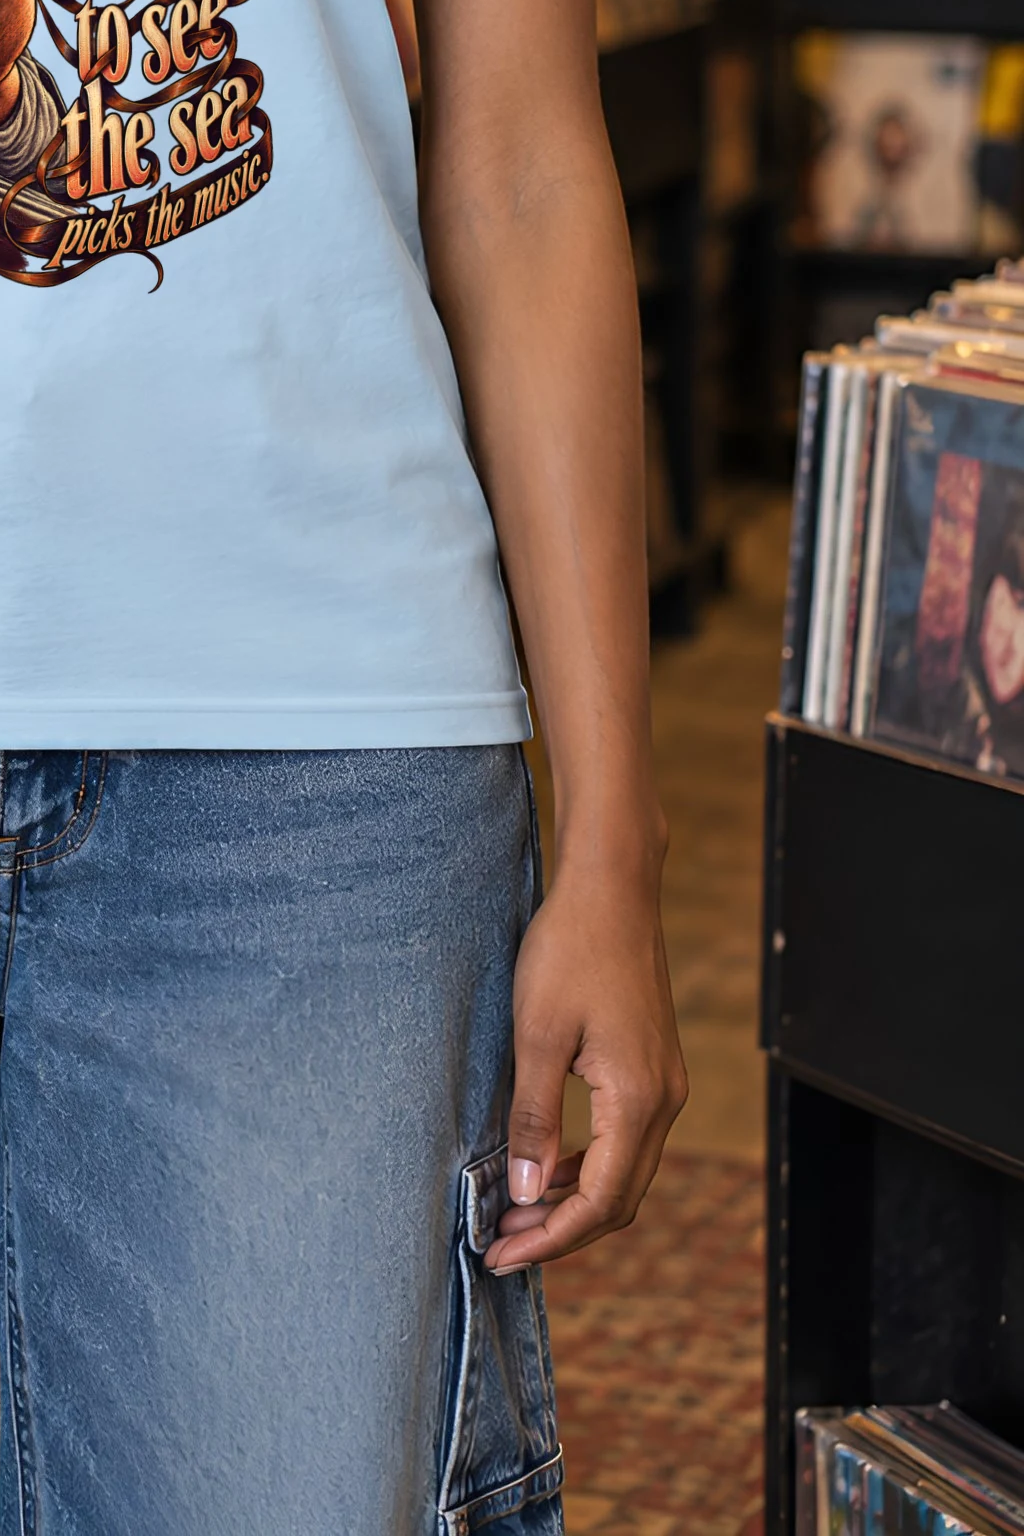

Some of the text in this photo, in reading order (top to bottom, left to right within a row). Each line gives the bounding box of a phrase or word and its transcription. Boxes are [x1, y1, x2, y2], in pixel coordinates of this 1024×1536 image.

[61, 75, 254, 200] the sea
[43, 149, 270, 269] picks the music.
